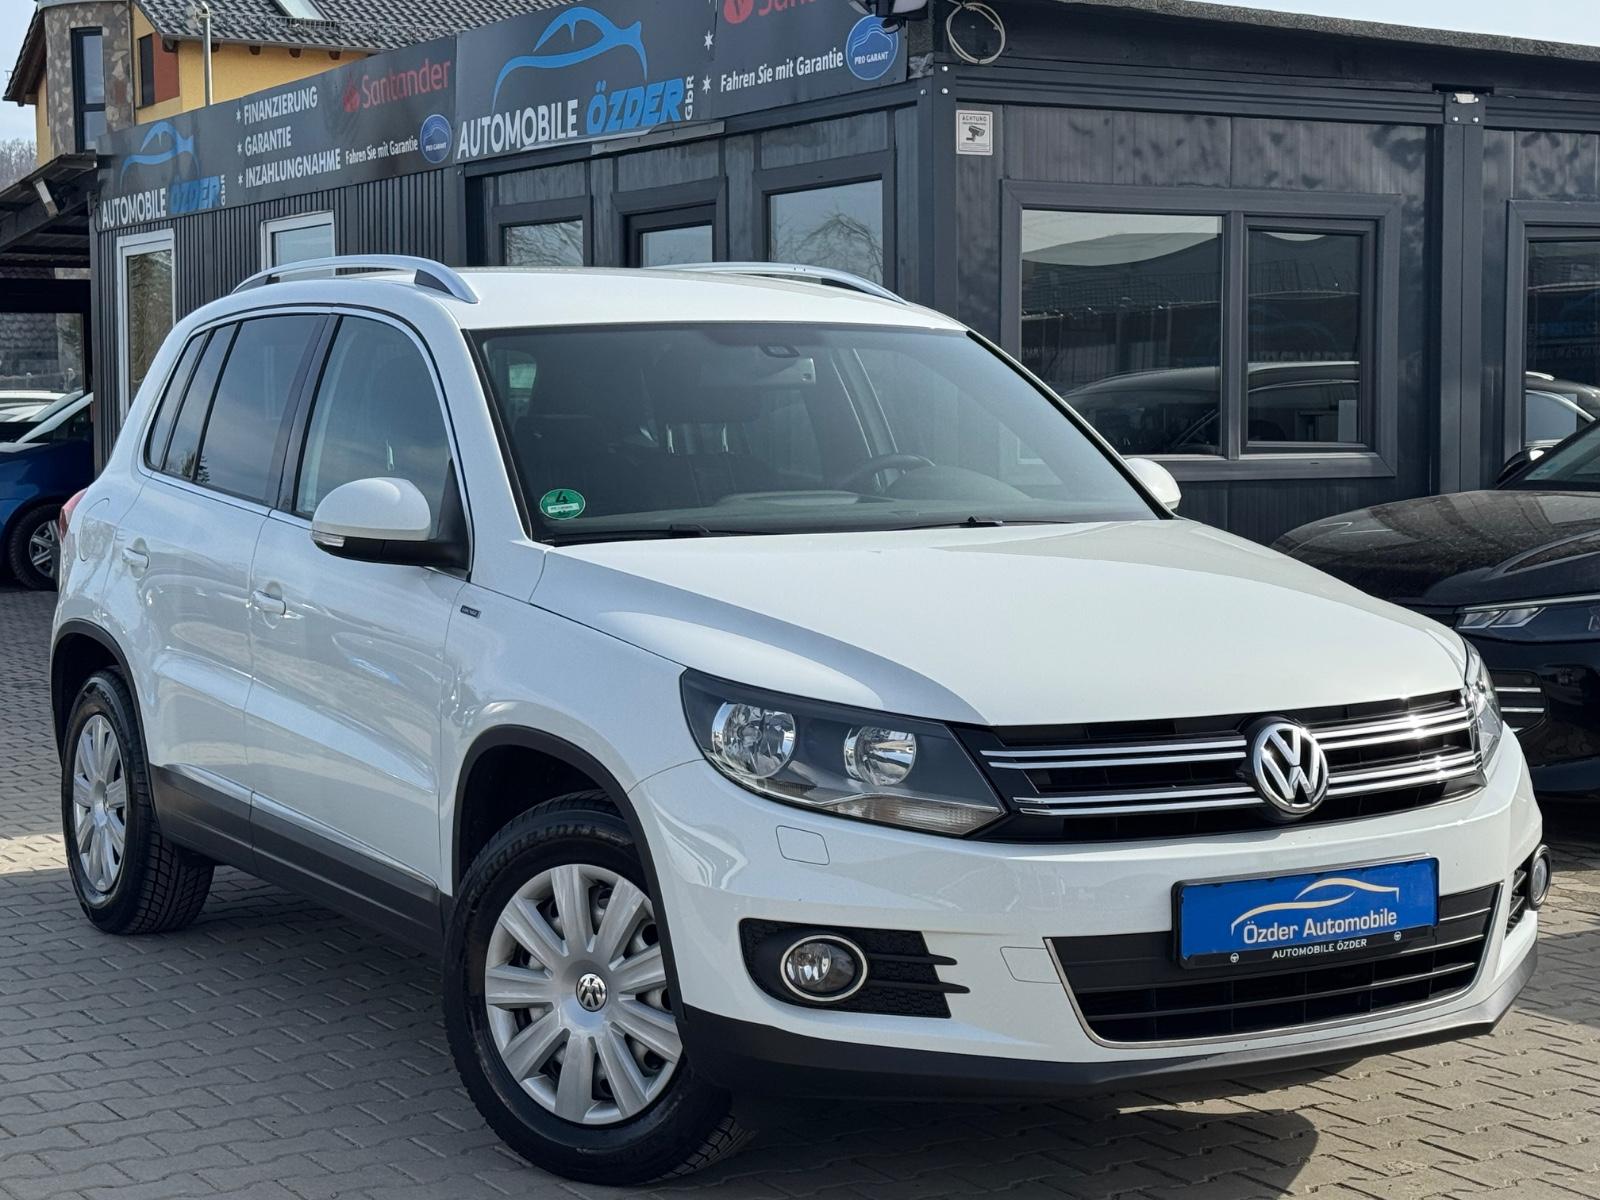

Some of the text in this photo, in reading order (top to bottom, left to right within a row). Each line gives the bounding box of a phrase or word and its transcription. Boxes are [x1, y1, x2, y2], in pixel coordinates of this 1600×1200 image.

[720, 47, 844, 93] Fahren Sie mit Garantie
[854, 51, 889, 66] PRO GARANT
[362, 58, 452, 110] Santander
[684, 74, 695, 121] GbR
[243, 85, 318, 126] FINANZIERUNG
[456, 78, 686, 160] AUTOMOBILE ÖZDER
[244, 125, 292, 157] GARANTIE
[345, 135, 419, 165] Fahren Sie mit Garantie
[245, 147, 341, 184] INZAHLUNGNAHME
[101, 187, 167, 230] AUTOMOBILE
[556, 491, 568, 504] 4
[1243, 908, 1397, 944] Özder Automobile
[1271, 939, 1367, 960] AUTOMOBILE ÖZDER
